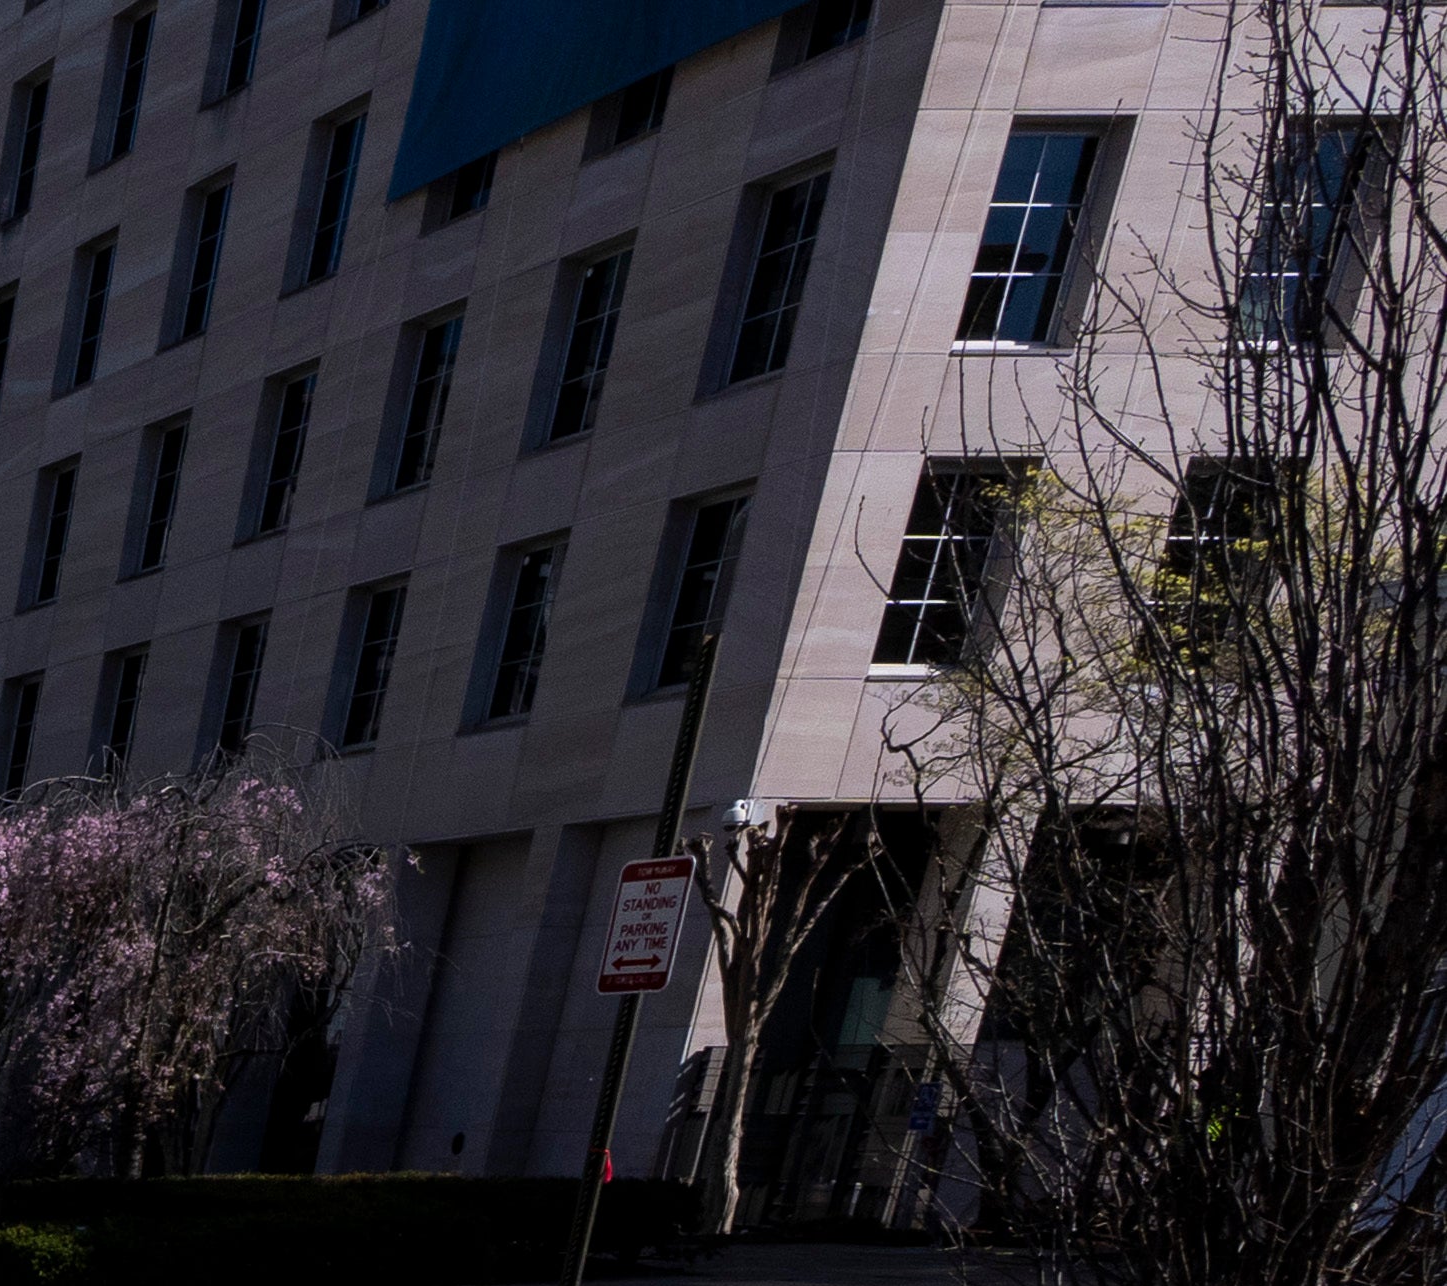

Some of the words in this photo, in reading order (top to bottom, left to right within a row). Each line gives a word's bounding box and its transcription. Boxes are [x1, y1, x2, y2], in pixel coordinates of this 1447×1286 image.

[644, 882, 661, 895] NO
[622, 895, 677, 912] STANDING
[620, 922, 668, 937] PARKING
[613, 939, 638, 952] ANY
[644, 936, 668, 950] TIME
